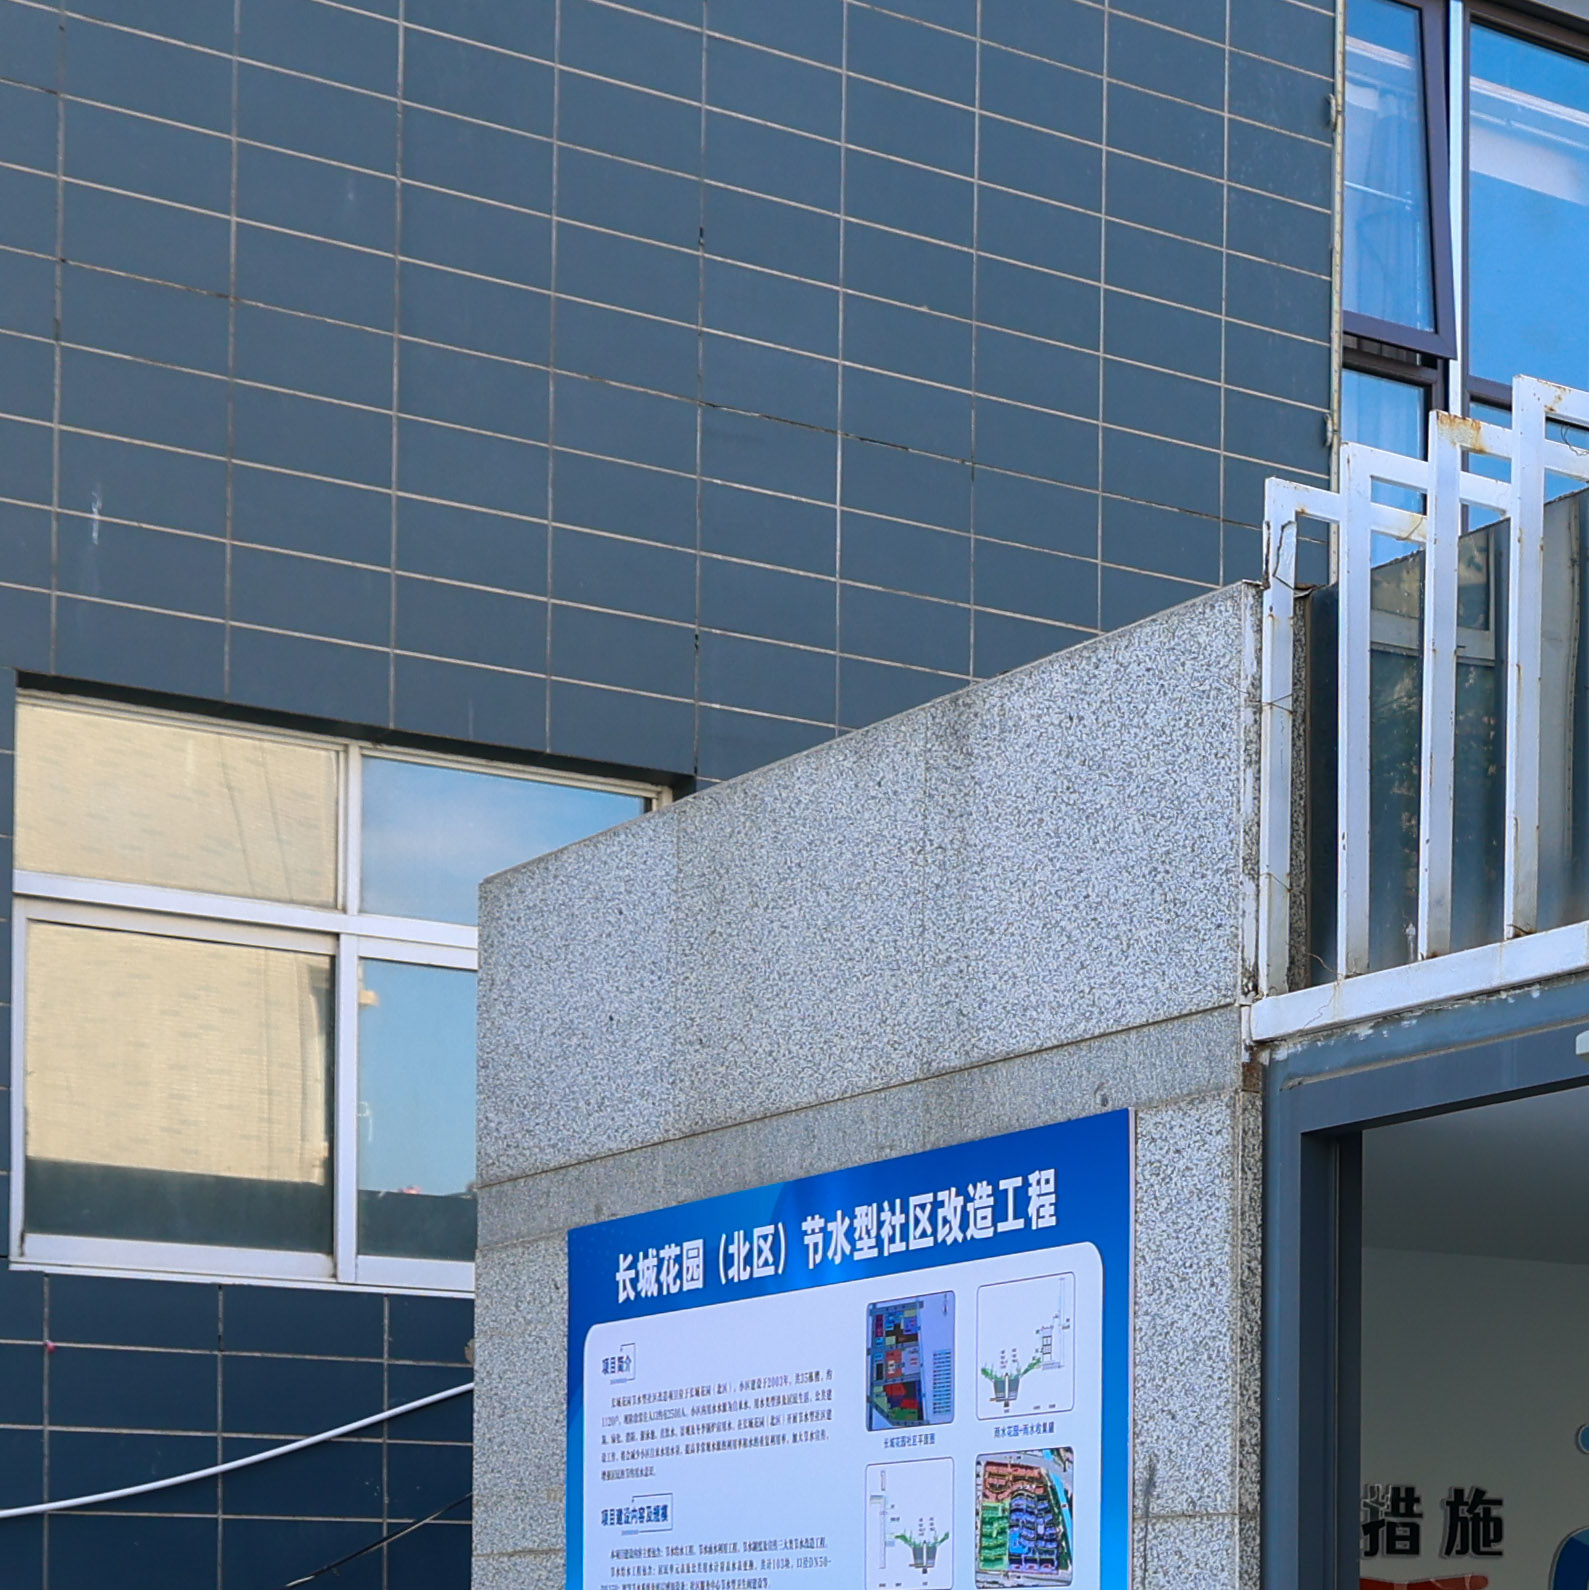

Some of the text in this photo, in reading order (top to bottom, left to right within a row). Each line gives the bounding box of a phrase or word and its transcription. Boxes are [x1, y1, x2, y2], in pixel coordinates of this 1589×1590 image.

[615, 1167, 1057, 1304] 长城花园（北区）节水型社区改造工程
[1363, 1484, 1505, 1557] 措施
